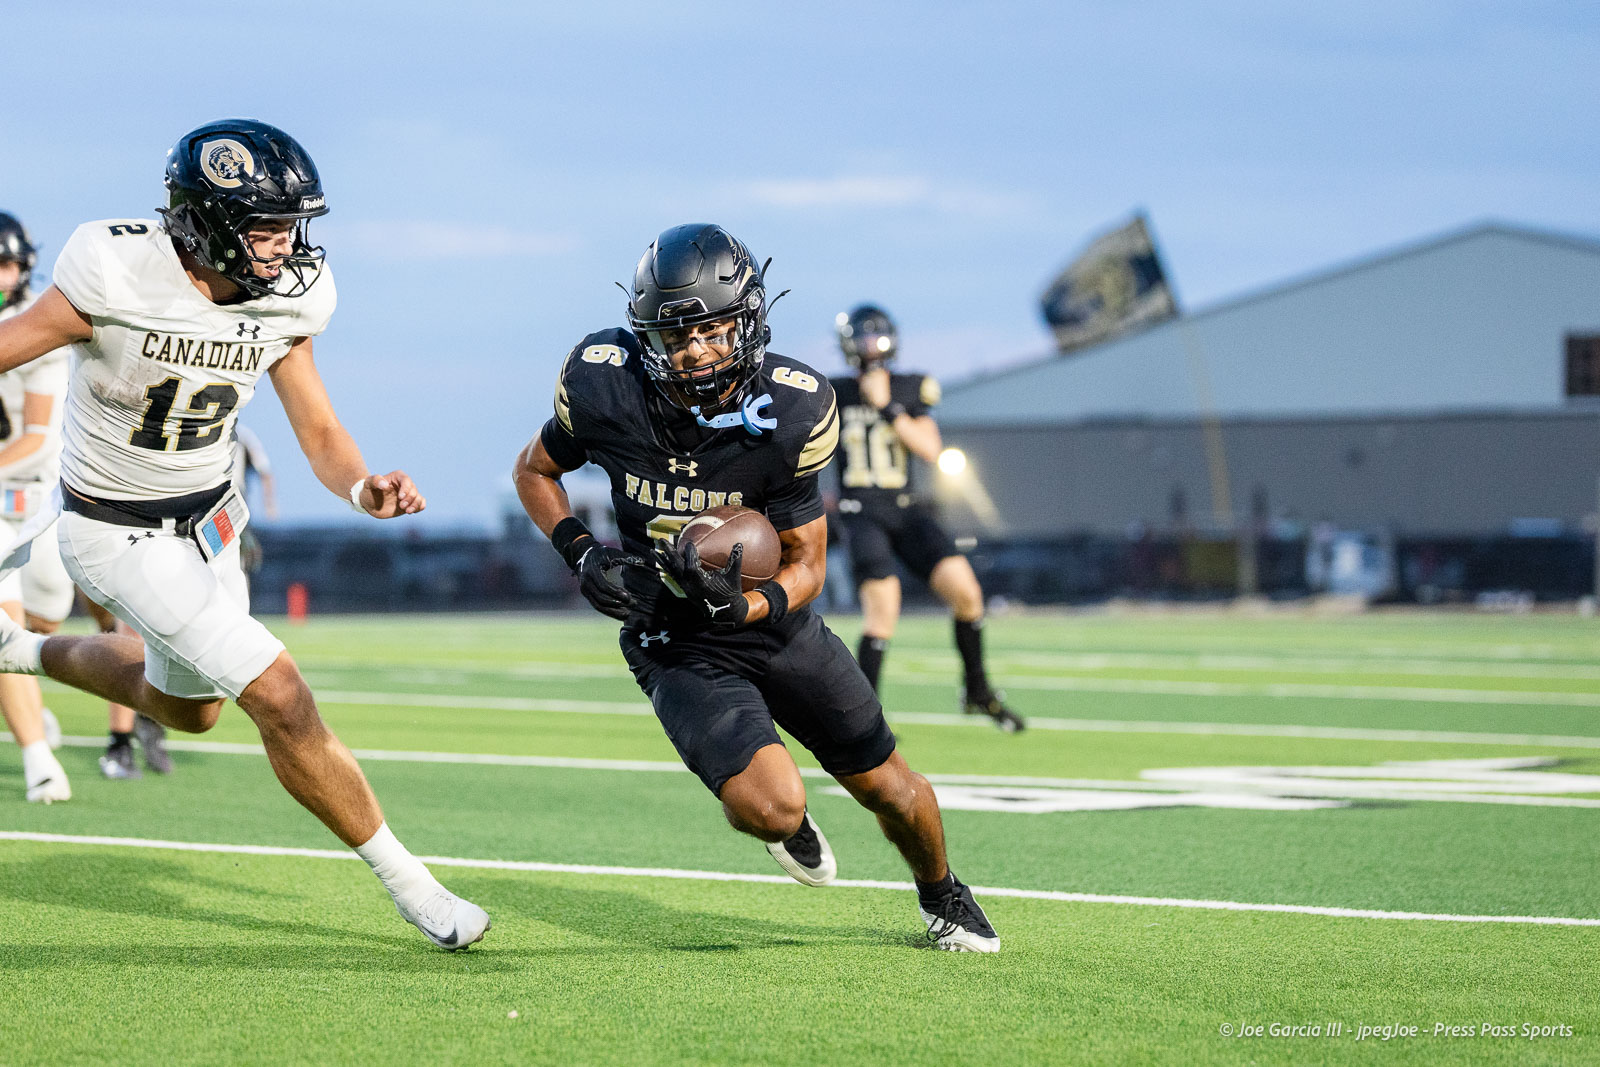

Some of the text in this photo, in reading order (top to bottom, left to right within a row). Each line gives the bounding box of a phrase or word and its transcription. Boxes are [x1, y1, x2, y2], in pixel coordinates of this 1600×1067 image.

[140, 331, 265, 372] CANADIAN
[581, 344, 629, 367] 6
[771, 366, 819, 392] 6
[128, 376, 240, 451] 12
[841, 421, 908, 488] 10
[625, 472, 743, 511] FALCONS
